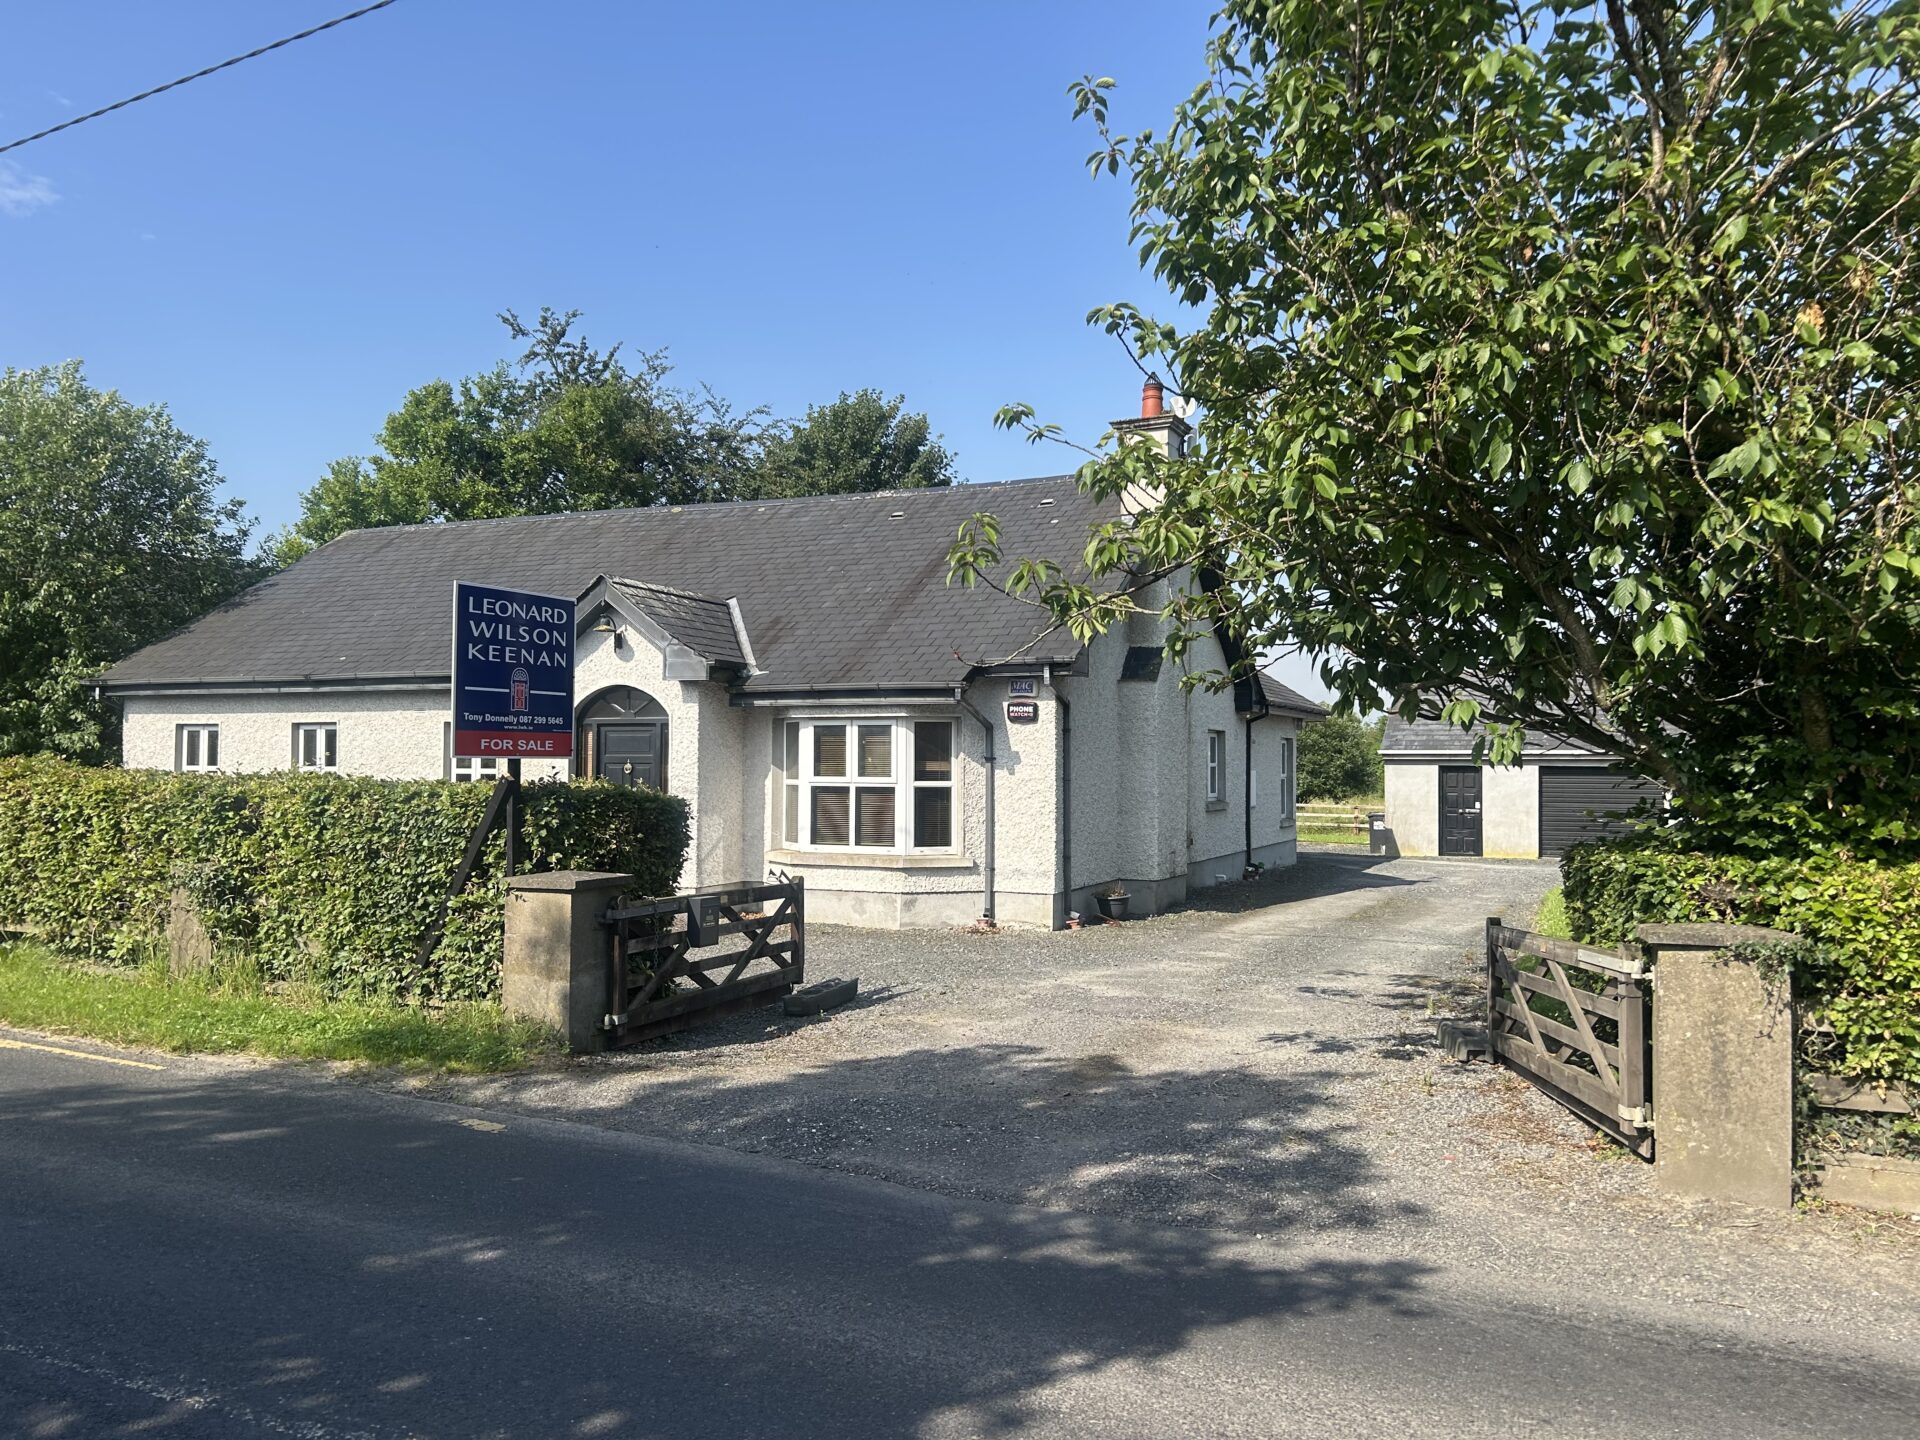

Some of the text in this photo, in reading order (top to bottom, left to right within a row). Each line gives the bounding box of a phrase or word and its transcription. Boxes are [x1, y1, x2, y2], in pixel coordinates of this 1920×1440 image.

[468, 596, 567, 624] LEONARD
[469, 620, 567, 647] WILSON
[468, 643, 566, 668] KEENAN
[463, 712, 564, 725] Tony Donnelly 087 299 5645
[480, 738, 554, 751] FOR SALE
